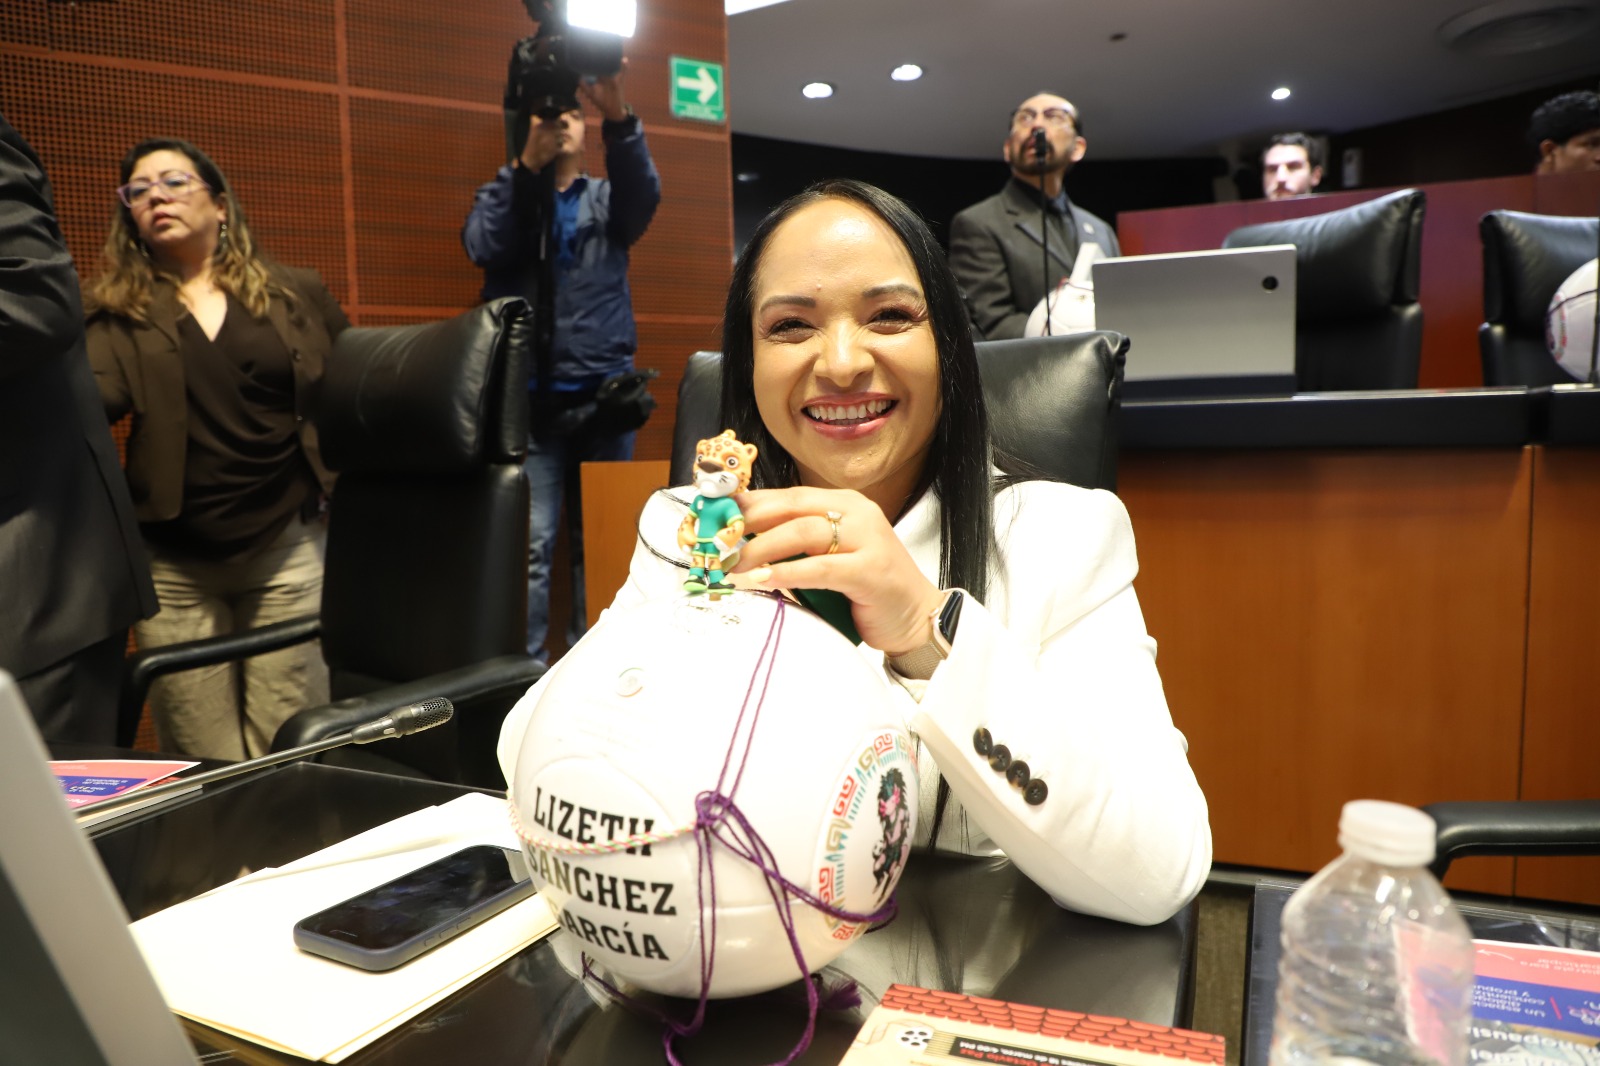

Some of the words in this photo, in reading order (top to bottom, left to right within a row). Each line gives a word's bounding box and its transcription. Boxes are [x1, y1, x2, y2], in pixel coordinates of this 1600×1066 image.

[534, 786, 655, 857] LIZETH
[1524, 1008, 1546, 1018] Un
[959, 1041, 976, 1050] PM
[1034, 1054, 1048, 1063] de
